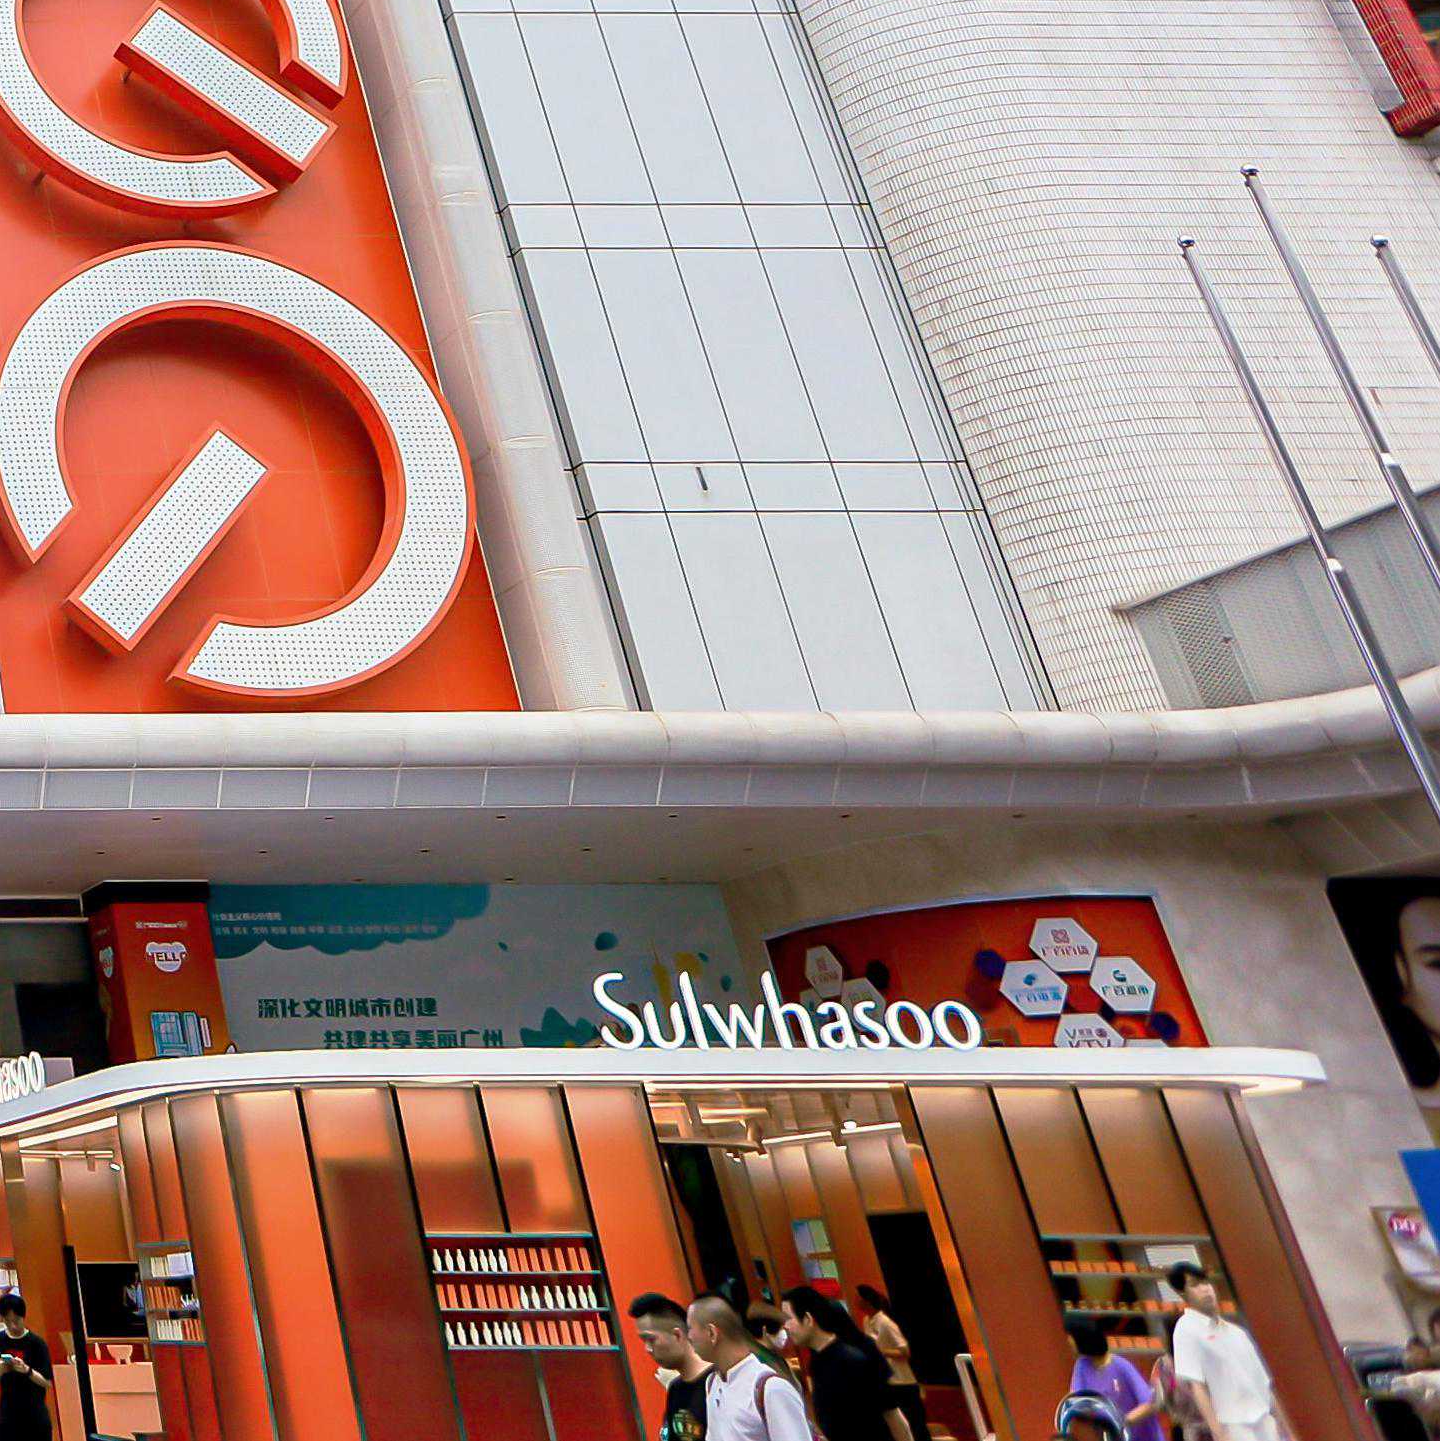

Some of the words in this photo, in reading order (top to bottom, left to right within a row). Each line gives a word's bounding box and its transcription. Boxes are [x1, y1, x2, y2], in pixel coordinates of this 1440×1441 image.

[257, 997, 438, 1018] 深化文明城市创建
[593, 971, 981, 1050] Sulwhasoo
[323, 1029, 503, 1049] 共建共享美丽广州
